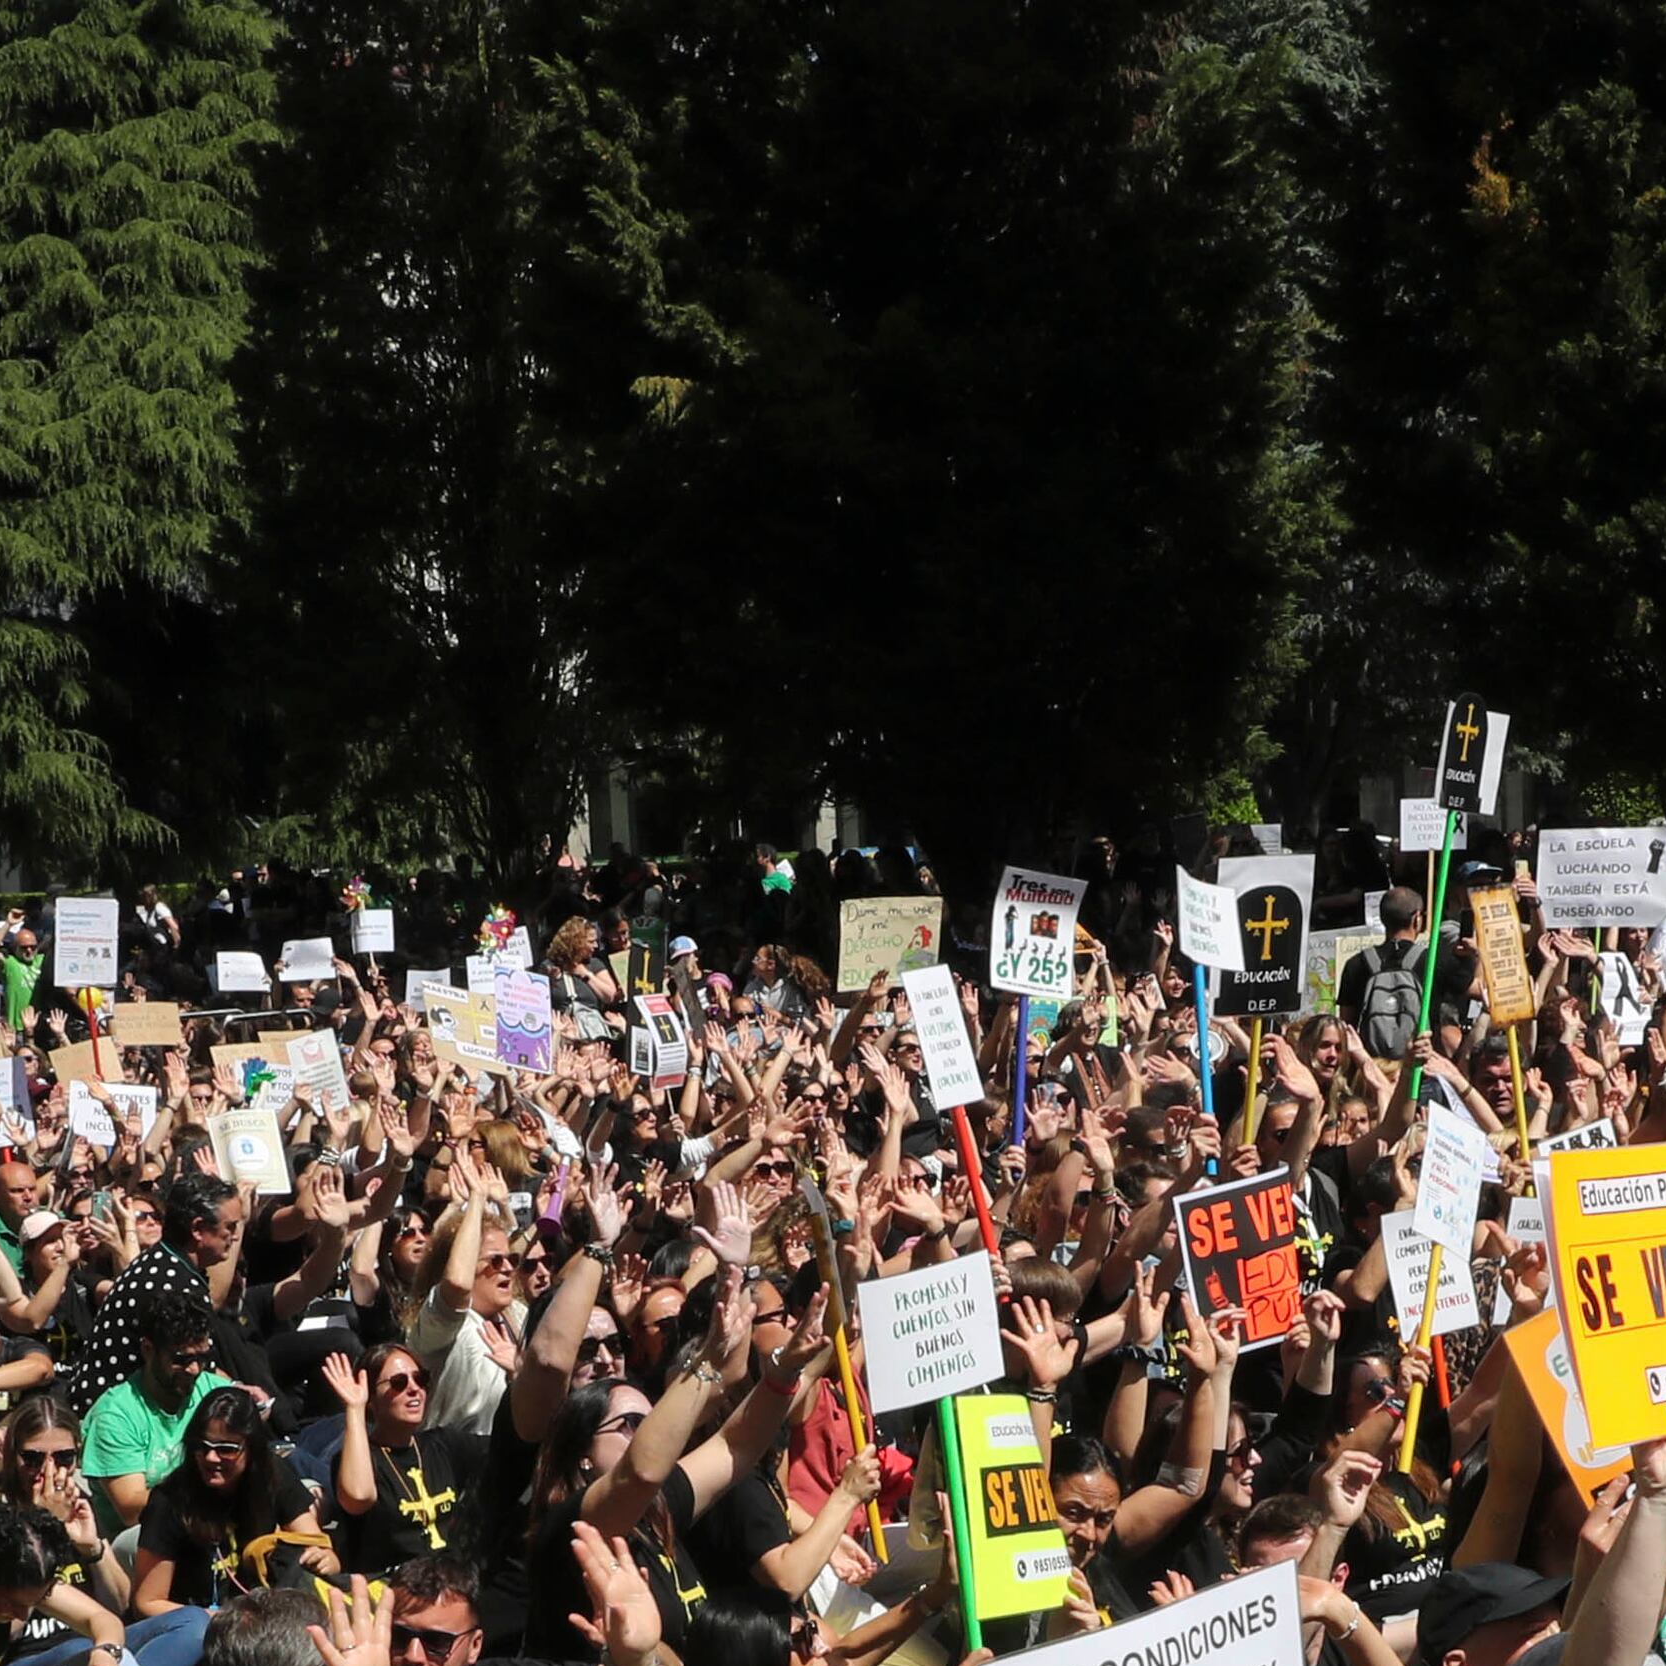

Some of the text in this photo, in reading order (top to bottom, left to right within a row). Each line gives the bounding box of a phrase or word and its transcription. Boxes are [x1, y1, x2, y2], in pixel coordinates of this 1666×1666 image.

[1550, 838, 1636, 853] LA ESCUELA
[1557, 863, 1632, 876] LUCHANDO
[1011, 874, 1047, 894] Tres
[1547, 881, 1649, 896] TAMBIÉN ESTÁ
[1005, 887, 1075, 907] Multitud
[846, 903, 879, 923] Dame
[1553, 904, 1635, 918] ENSEÑANDO
[846, 936, 905, 957] DERECHO
[996, 951, 1022, 981] ¿Y
[1028, 958, 1069, 988] 25?
[1234, 966, 1291, 984] EDUCACIÓN
[232, 1118, 267, 1129] BUSCA
[1582, 1177, 1654, 1210] Educación
[1187, 1200, 1239, 1259] SE
[894, 1272, 969, 1313] PROMESAS Y
[1576, 1253, 1625, 1331] SE
[954, 1298, 976, 1321] SIN
[915, 1327, 965, 1359] BUENOS
[907, 1351, 977, 1388] CIMIENTOS
[986, 1470, 1020, 1529] SE
